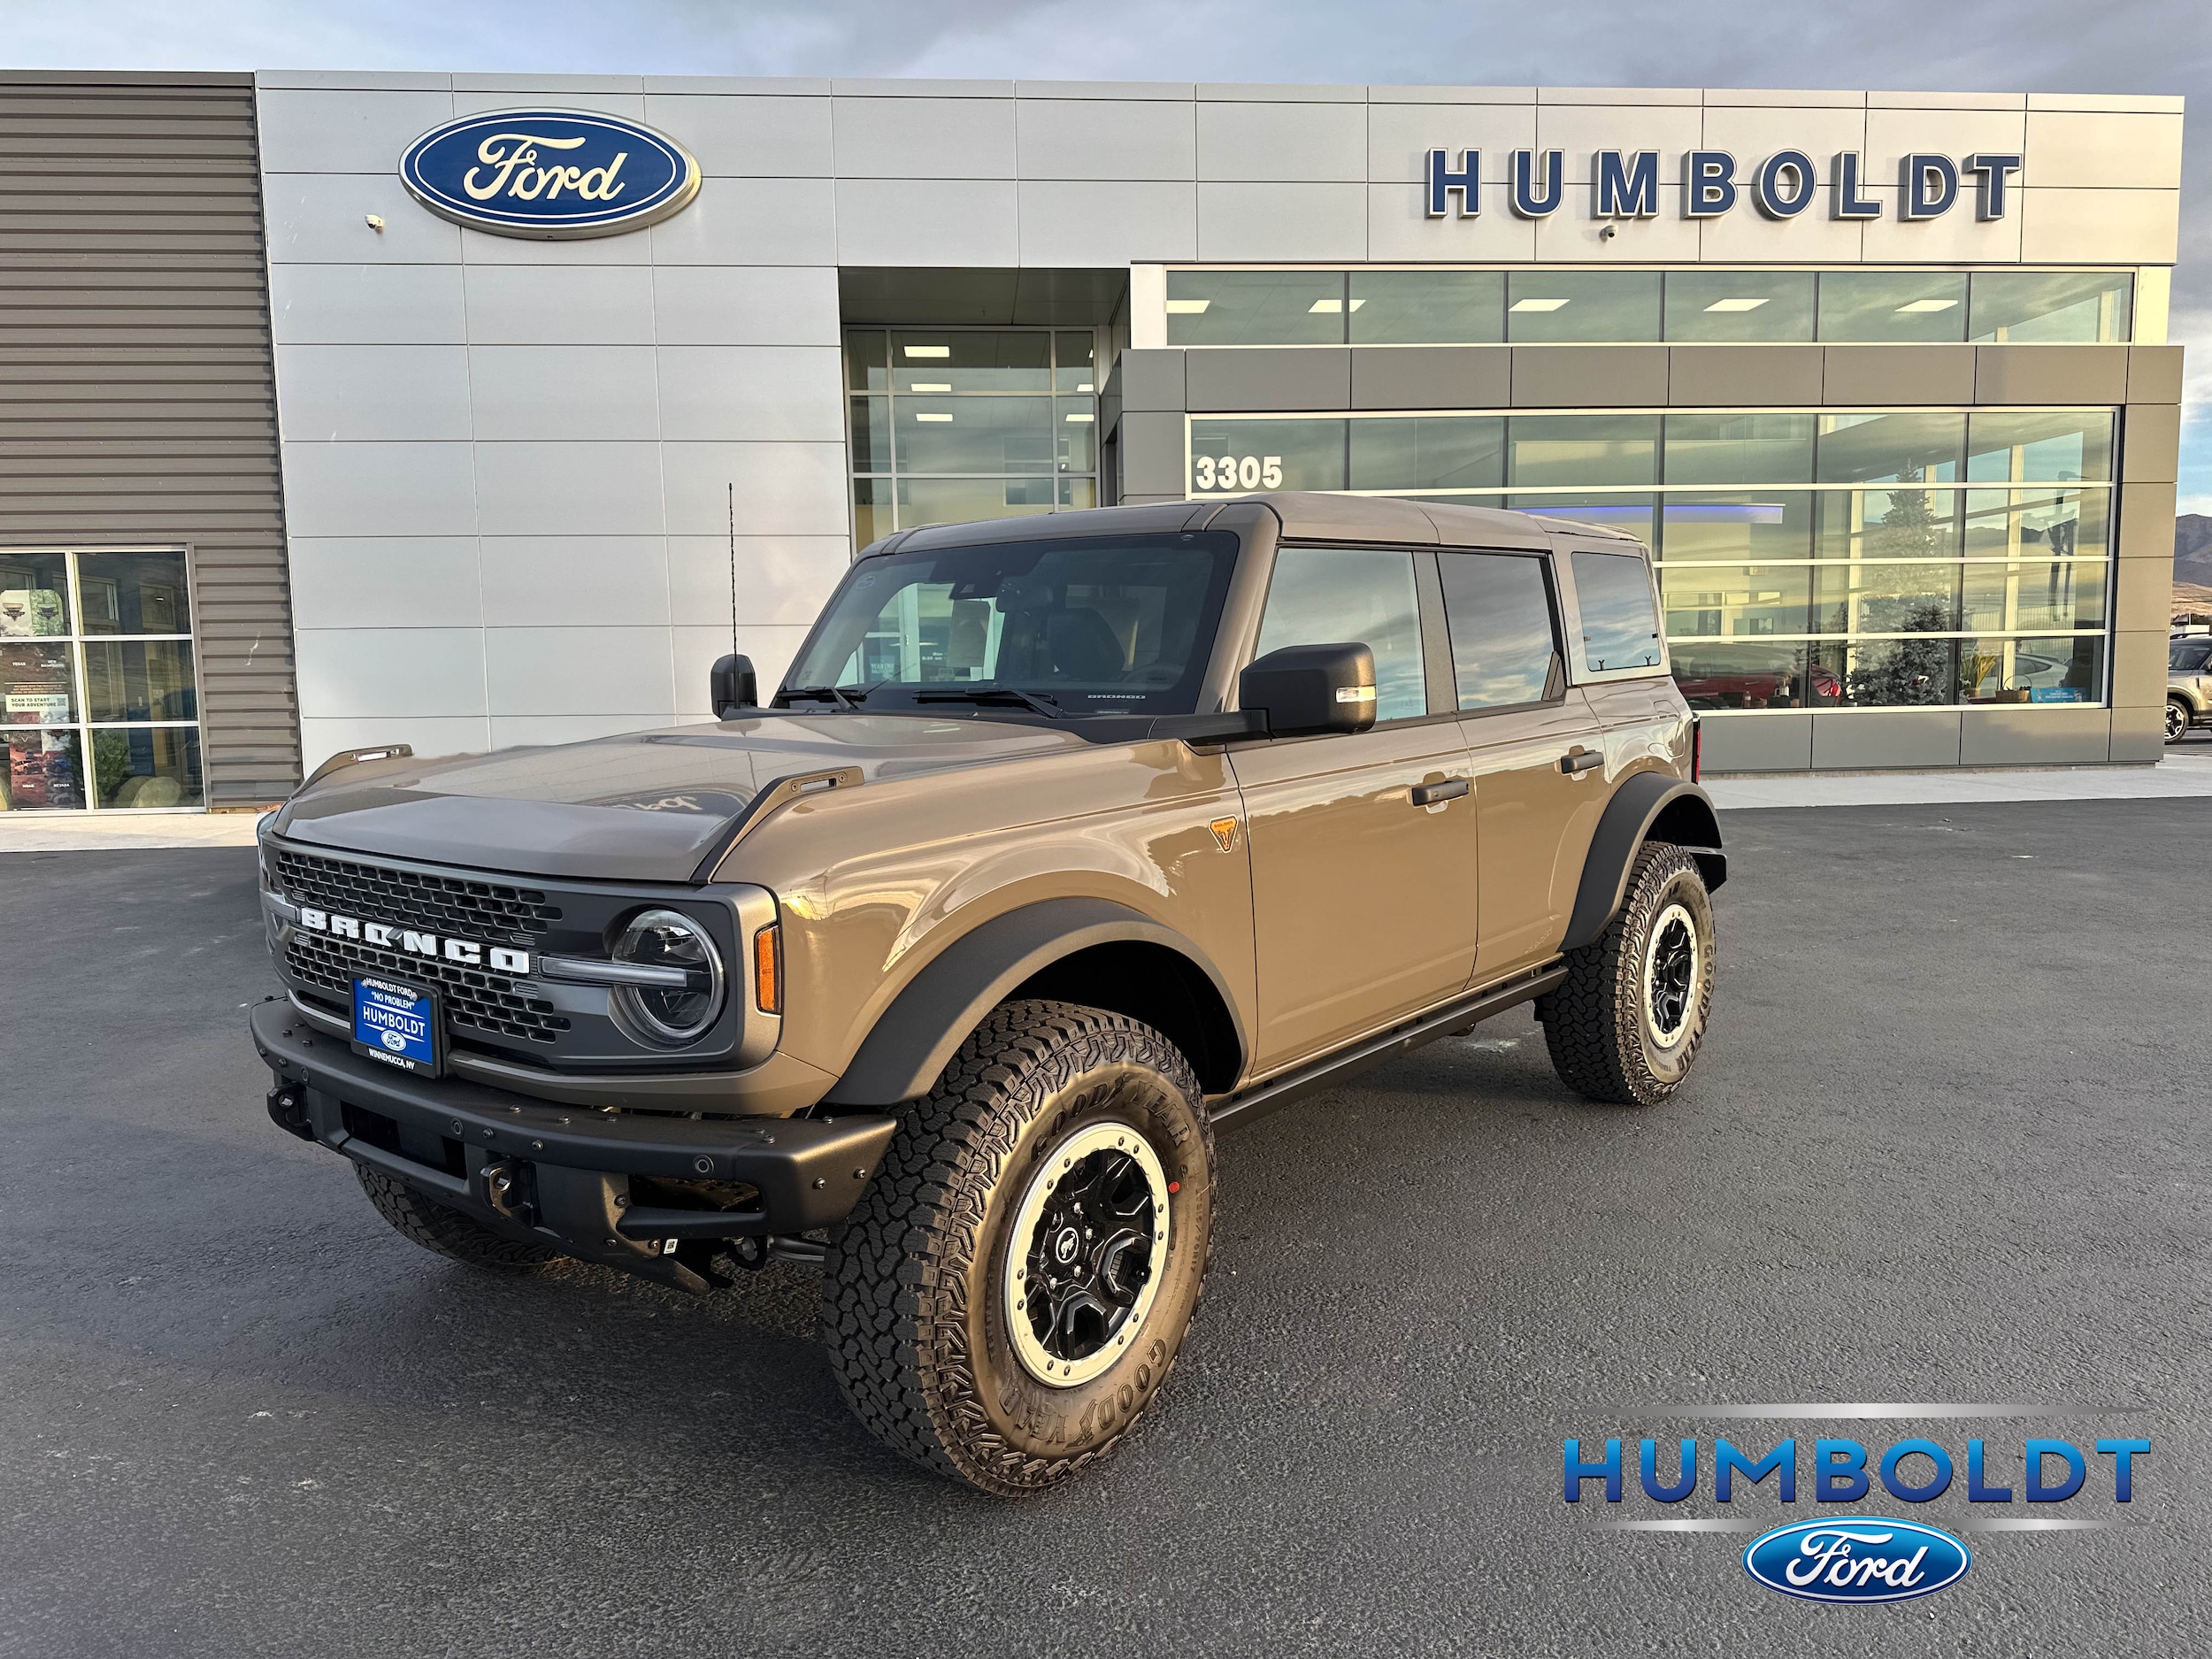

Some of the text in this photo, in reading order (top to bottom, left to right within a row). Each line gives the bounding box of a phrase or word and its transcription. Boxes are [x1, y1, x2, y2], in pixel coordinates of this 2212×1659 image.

[464, 134, 628, 200] Ford
[1425, 147, 2022, 221] HUMBOLDT
[1195, 456, 1283, 489] 3305
[302, 907, 531, 975] BRONCO
[365, 977, 412, 999] HUMBOLDT FORD
[363, 1006, 426, 1037] HUMBOLDT
[387, 1033, 401, 1048] Ford
